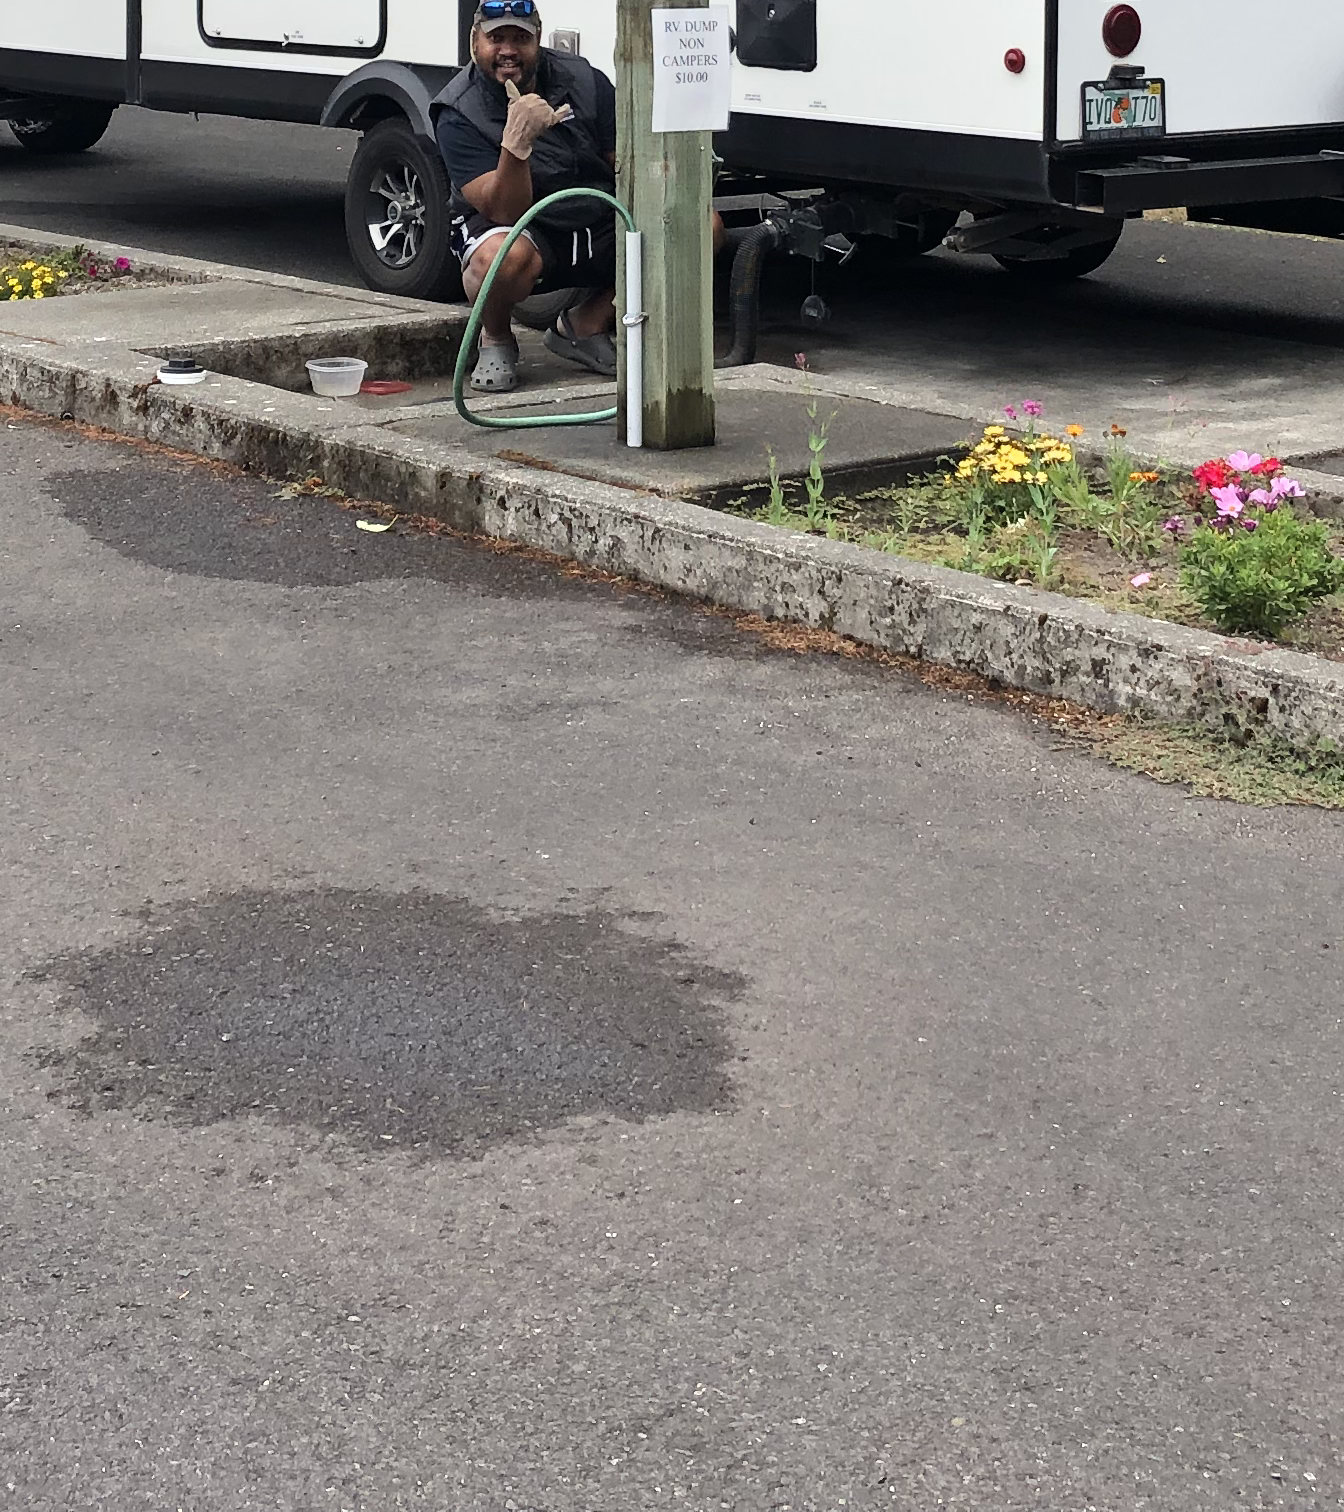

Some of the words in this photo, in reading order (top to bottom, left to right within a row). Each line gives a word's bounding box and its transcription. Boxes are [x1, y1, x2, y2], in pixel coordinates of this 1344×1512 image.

[685, 20, 718, 33] DUMP
[679, 38, 705, 49] NON
[662, 54, 718, 67] CAMPERS
[675, 71, 708, 84] $10.00
